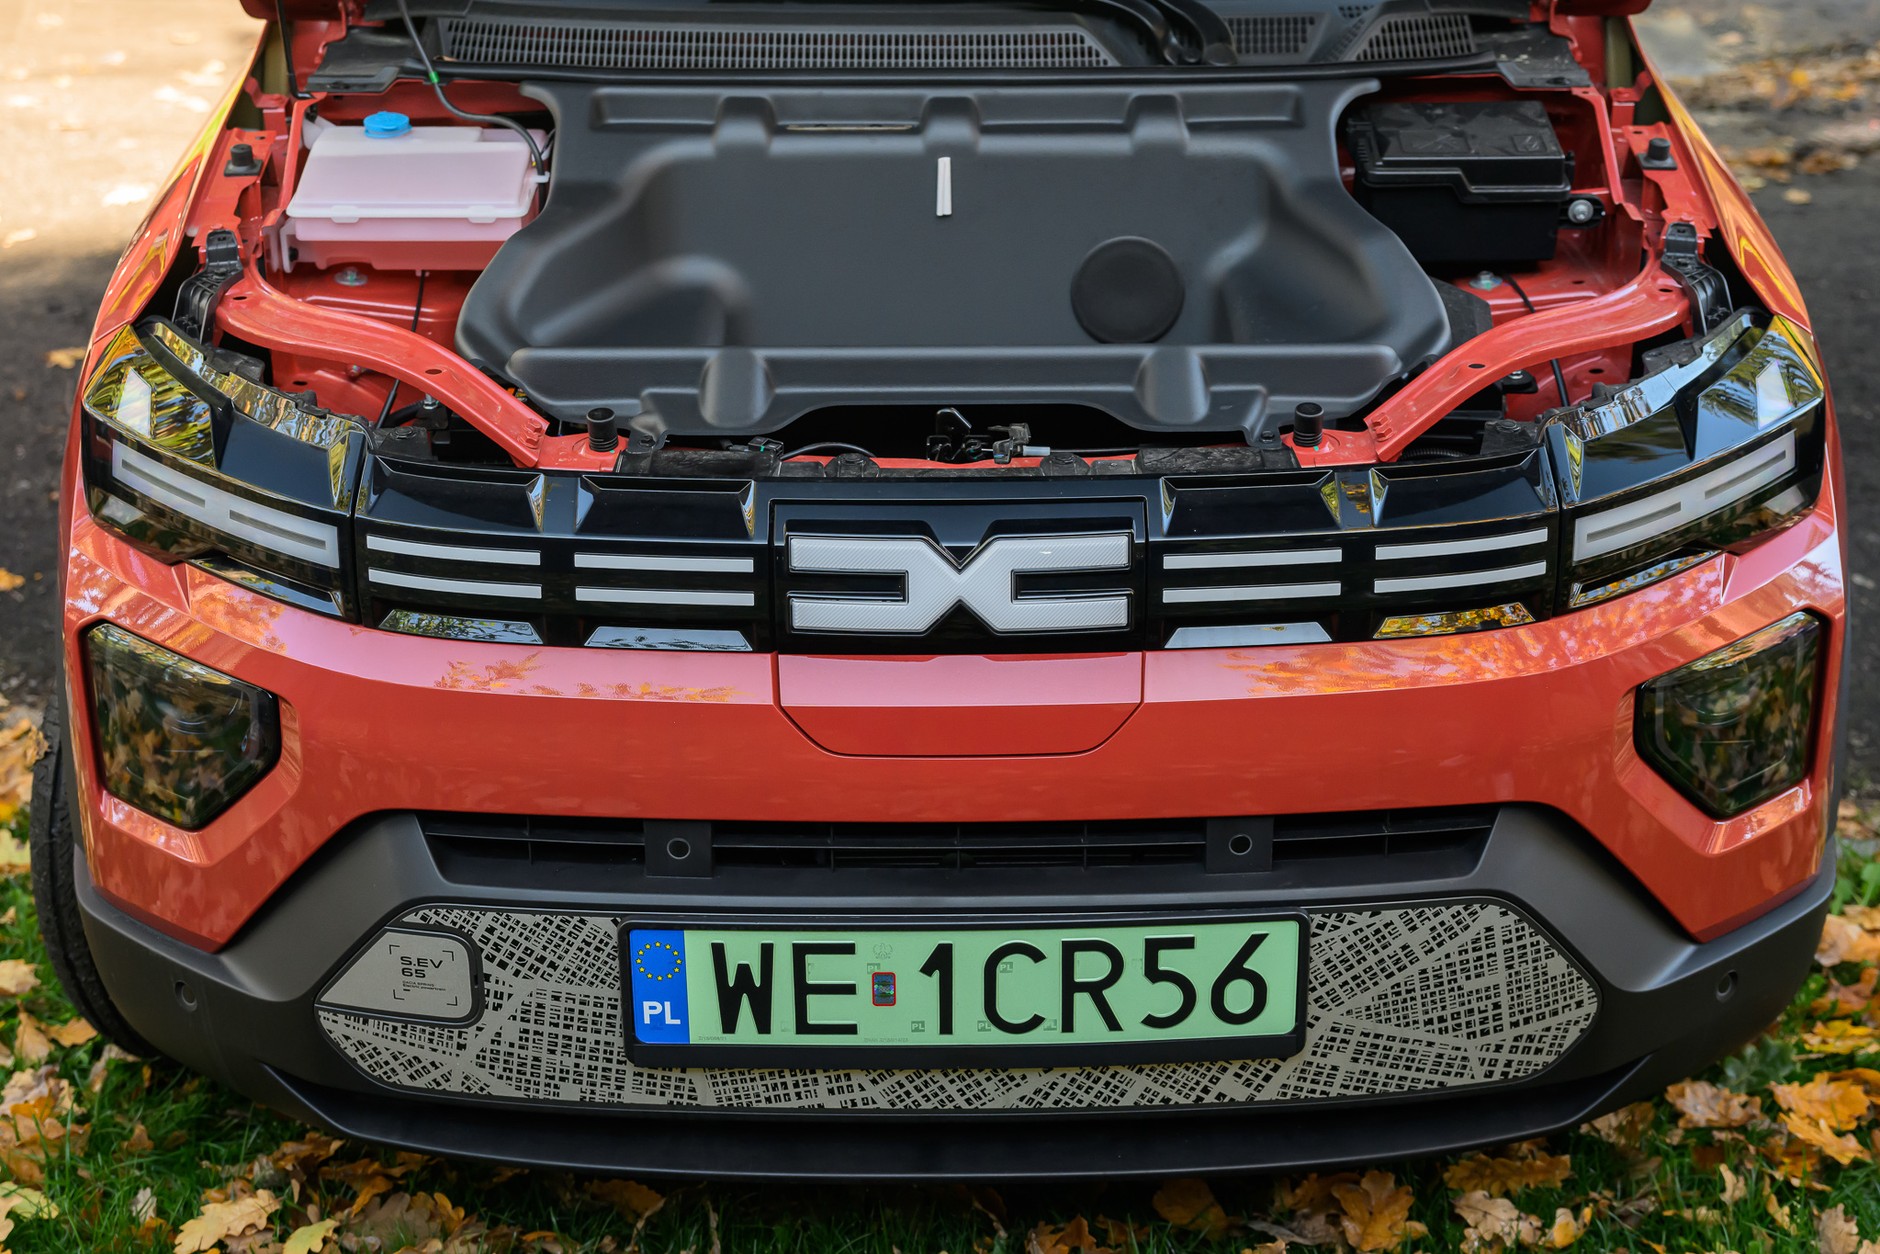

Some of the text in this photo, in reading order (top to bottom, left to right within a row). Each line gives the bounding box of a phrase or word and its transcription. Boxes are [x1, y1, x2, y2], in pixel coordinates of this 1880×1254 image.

[400, 956, 443, 969] S.EV
[401, 967, 426, 978] 65
[711, 932, 1270, 1036] WE 1CR56
[642, 1001, 681, 1025] PL
